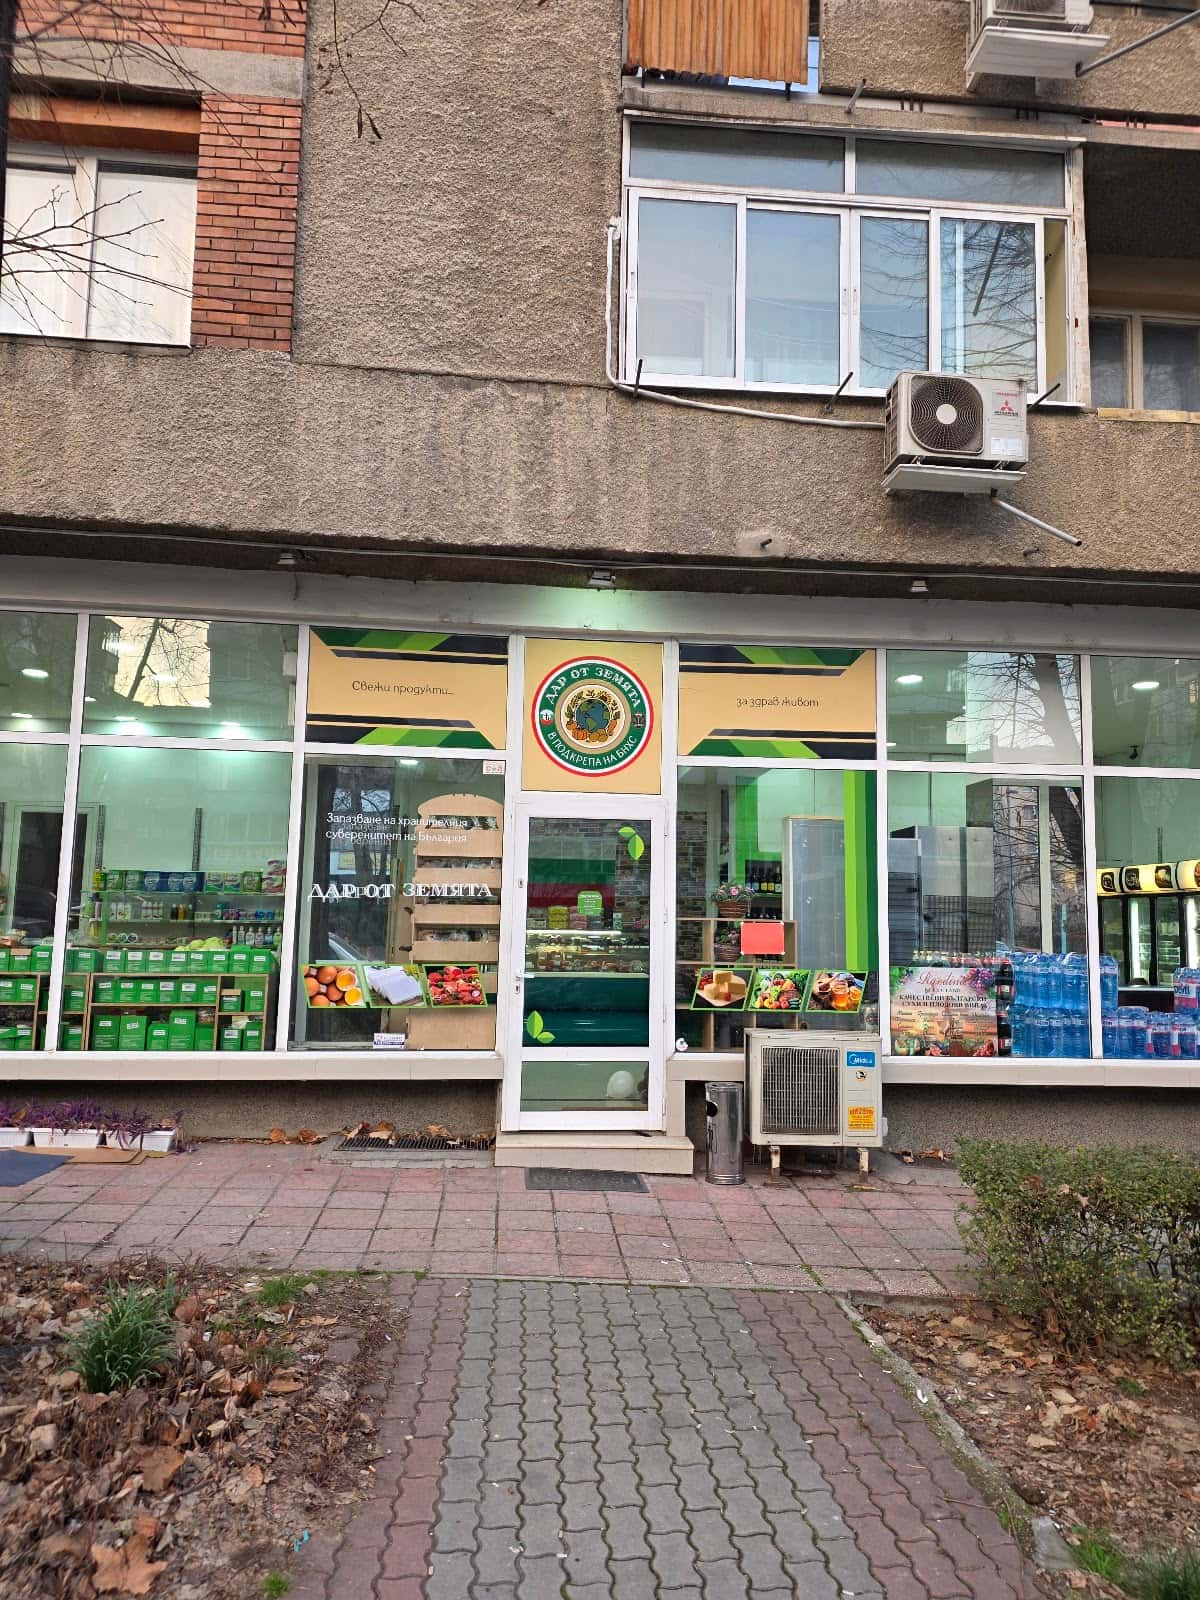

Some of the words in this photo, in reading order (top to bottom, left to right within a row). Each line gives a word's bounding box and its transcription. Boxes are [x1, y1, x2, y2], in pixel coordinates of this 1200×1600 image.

[352, 680, 391, 692] Свежи
[545, 676, 567, 705] ДАР
[571, 667, 589, 679] ОТ
[595, 666, 641, 708] ЗЕМЯТА
[736, 697, 748, 708] за
[750, 697, 779, 708] здрав
[781, 697, 819, 708] живот
[547, 731, 556, 740] В
[552, 739, 602, 767] ПОДКРЕПА
[603, 754, 617, 766] НА
[617, 736, 638, 758] БНХС
[326, 812, 381, 826] Запазване
[384, 817, 396, 825] на
[325, 829, 401, 841] суверенитет
[404, 833, 416, 841] на
[418, 832, 467, 844] България
[308, 884, 356, 900] ДАР
[365, 884, 396, 898] ОТ
[402, 883, 493, 898] ЗЕМЯТА
